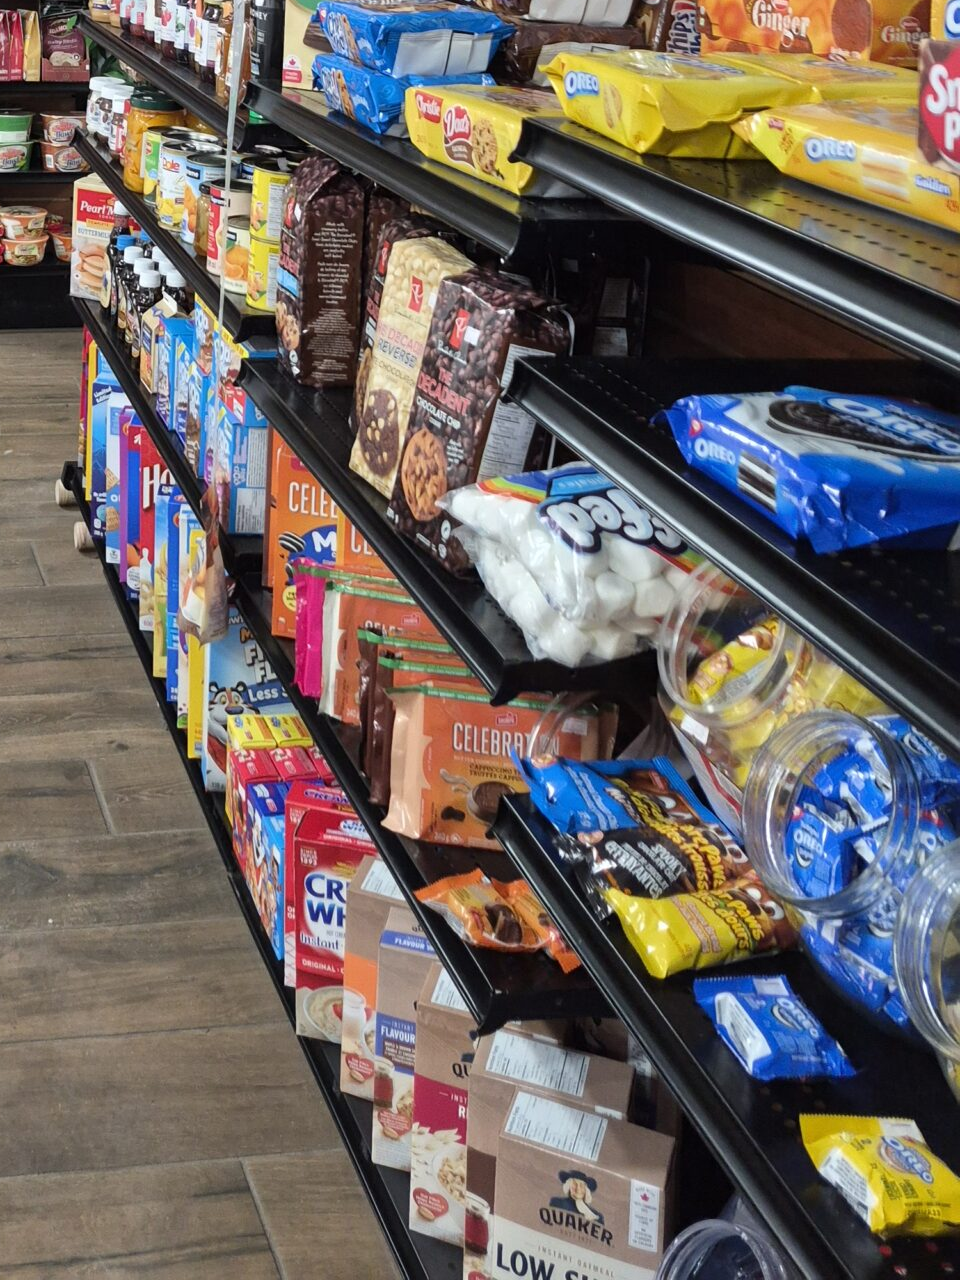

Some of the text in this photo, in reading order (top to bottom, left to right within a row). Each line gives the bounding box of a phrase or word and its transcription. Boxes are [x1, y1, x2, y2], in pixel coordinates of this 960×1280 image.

[666, 10, 691, 55] hips
[563, 73, 600, 96] OREO
[805, 138, 857, 161] OREO
[162, 158, 181, 172] Dole
[79, 200, 106, 215] Pearl
[416, 371, 472, 417] DECADENT
[693, 437, 736, 466] OREO
[248, 688, 279, 703] Less
[793, 828, 823, 853] OREO
[300, 858, 318, 867] 1893
[299, 932, 340, 951] Instant
[302, 958, 336, 974] ORIGINAL
[776, 996, 822, 1040] OREO
[380, 1026, 416, 1045] FLAVOUR
[450, 1094, 468, 1105] INST
[881, 1135, 935, 1185] OREO
[540, 1207, 614, 1247] QUAKER
[537, 1245, 574, 1264] INSTANT
